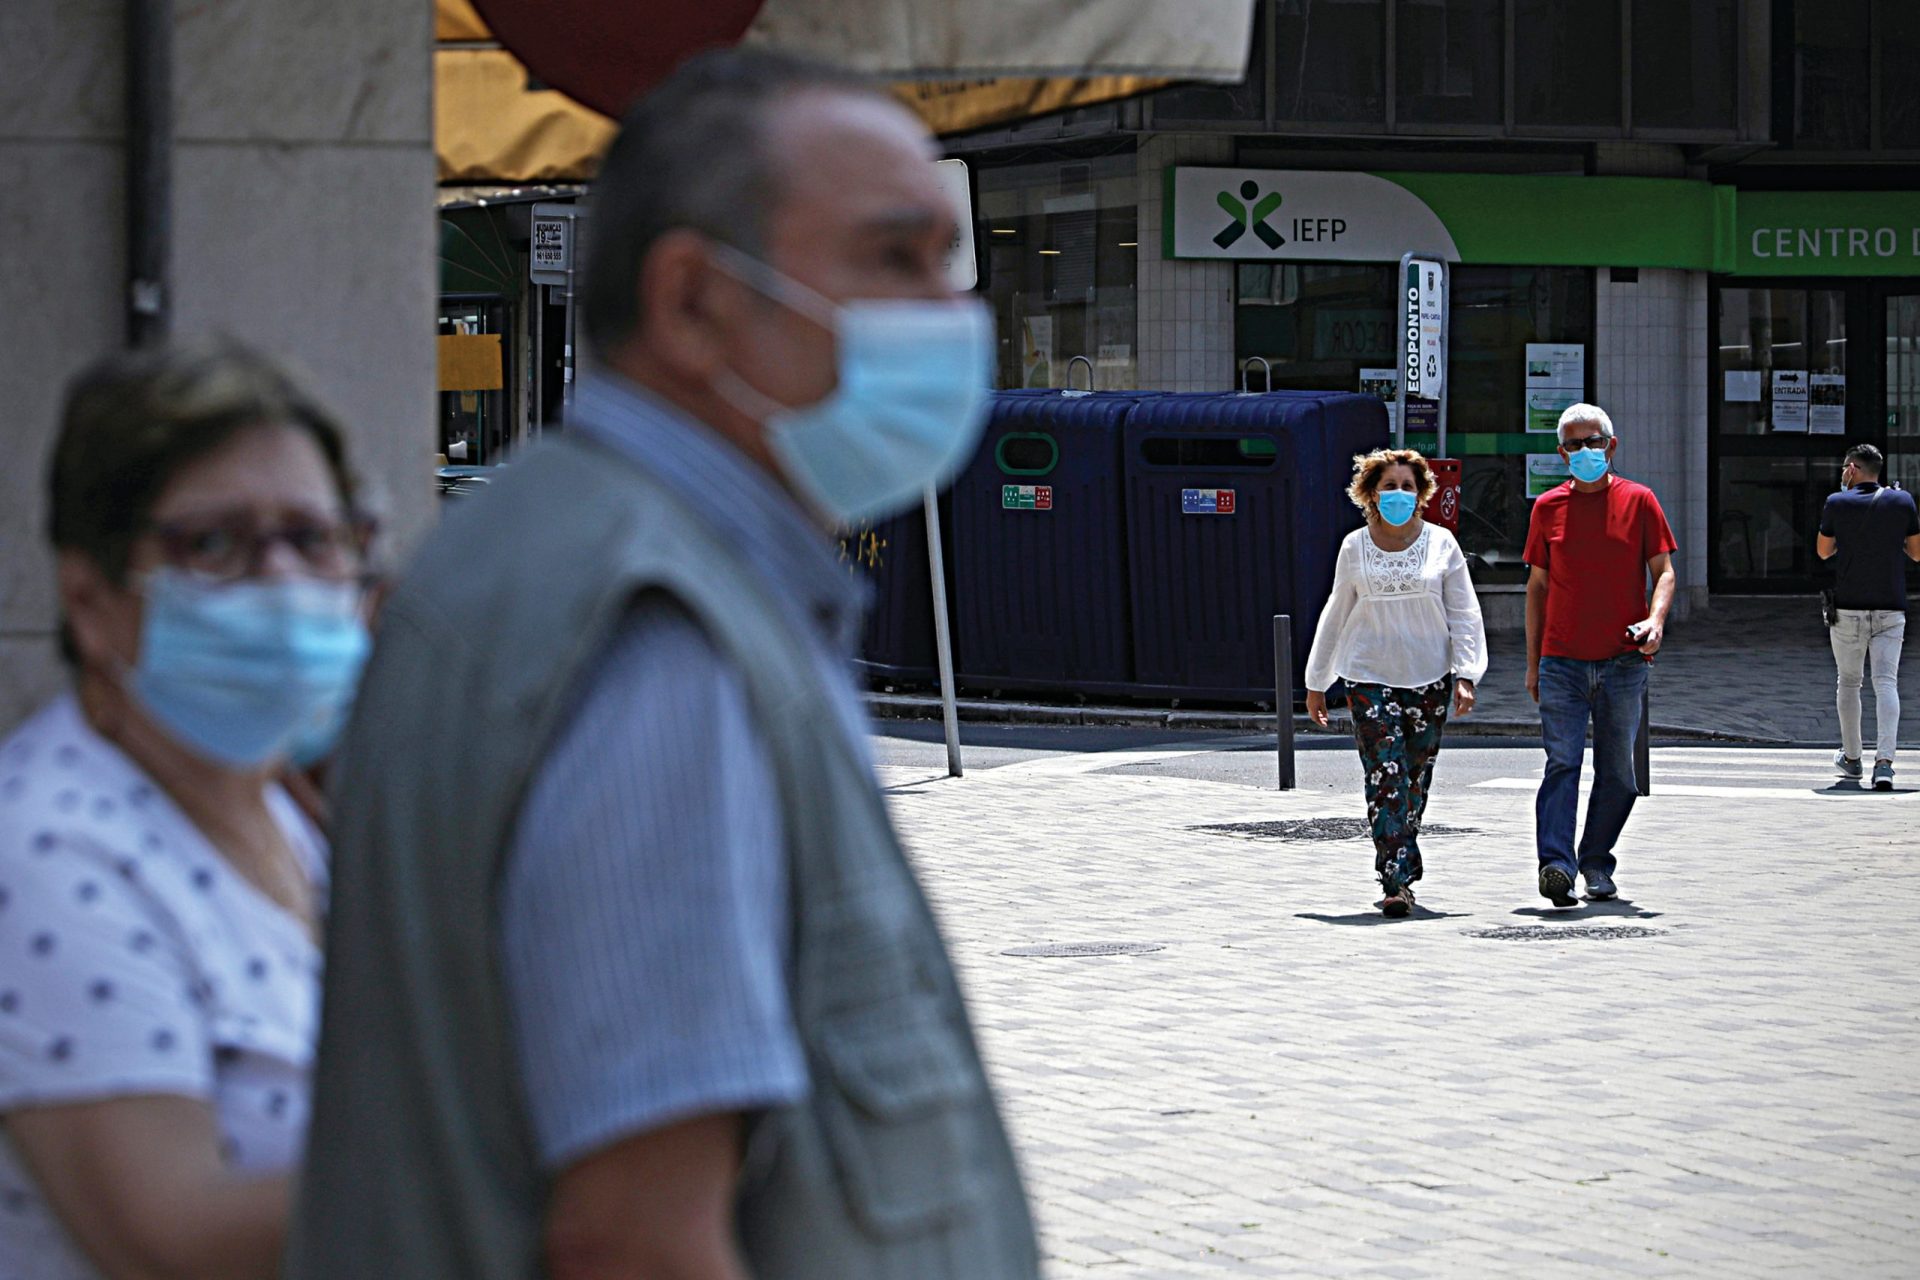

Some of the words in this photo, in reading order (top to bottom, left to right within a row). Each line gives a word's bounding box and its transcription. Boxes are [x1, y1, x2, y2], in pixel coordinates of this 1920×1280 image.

[1293, 218, 1347, 242] IEFP
[1752, 227, 1897, 257] CENTRO
[1407, 287, 1420, 392] ECOPONTO
[1774, 387, 1807, 395] ENTRADA
